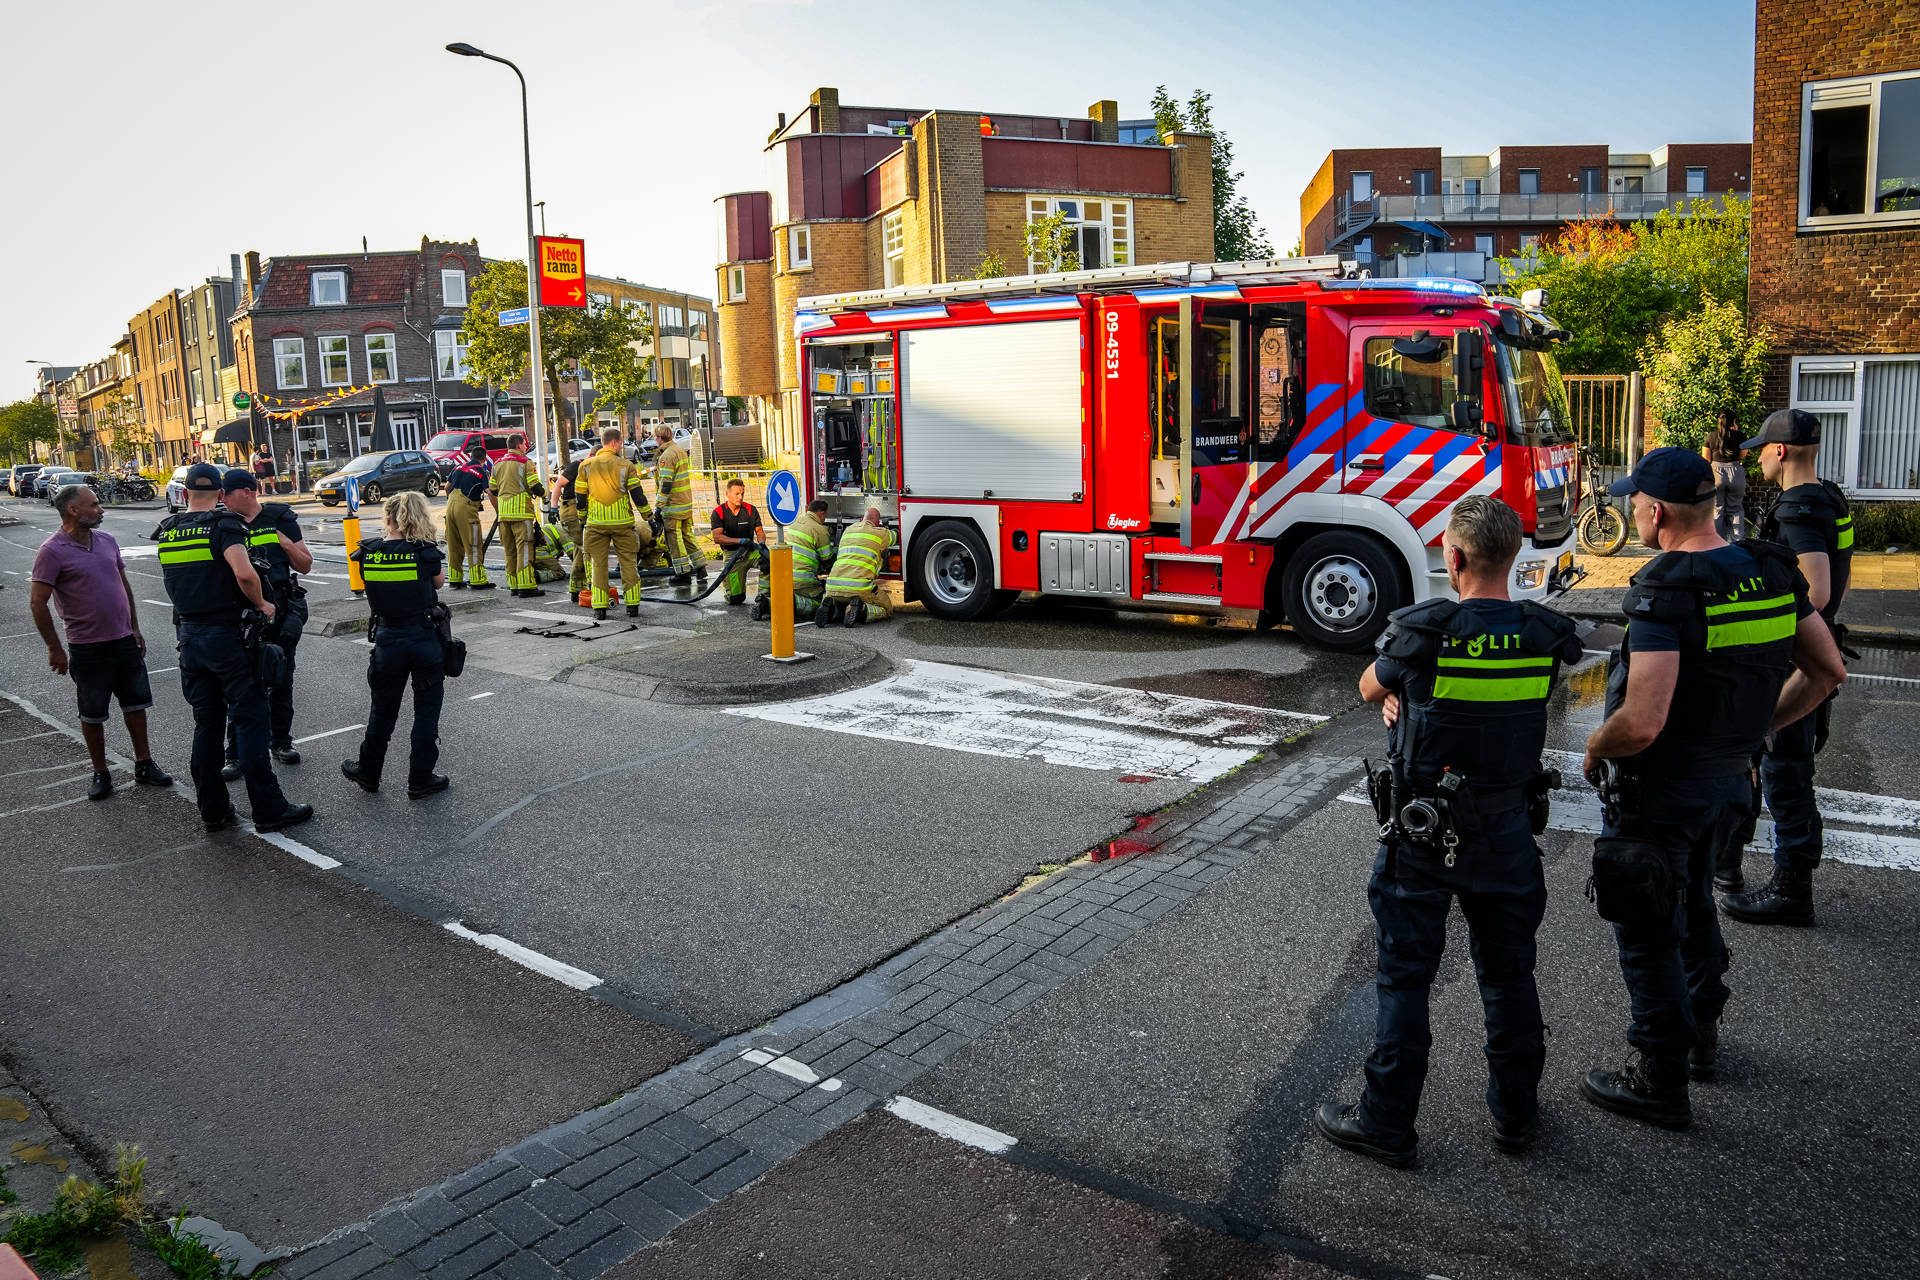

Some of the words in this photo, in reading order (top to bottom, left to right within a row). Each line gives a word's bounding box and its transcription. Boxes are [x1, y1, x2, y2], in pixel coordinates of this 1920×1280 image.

[546, 246, 577, 262] Netto
[547, 261, 578, 274] rama
[1106, 311, 1119, 379] 09-4531
[1195, 435, 1238, 447] BRANDWEER
[1107, 513, 1141, 529] Ziegler
[163, 527, 203, 541] POLITIE
[368, 551, 411, 563] POLITIE
[1451, 633, 1521, 657] POLIT
